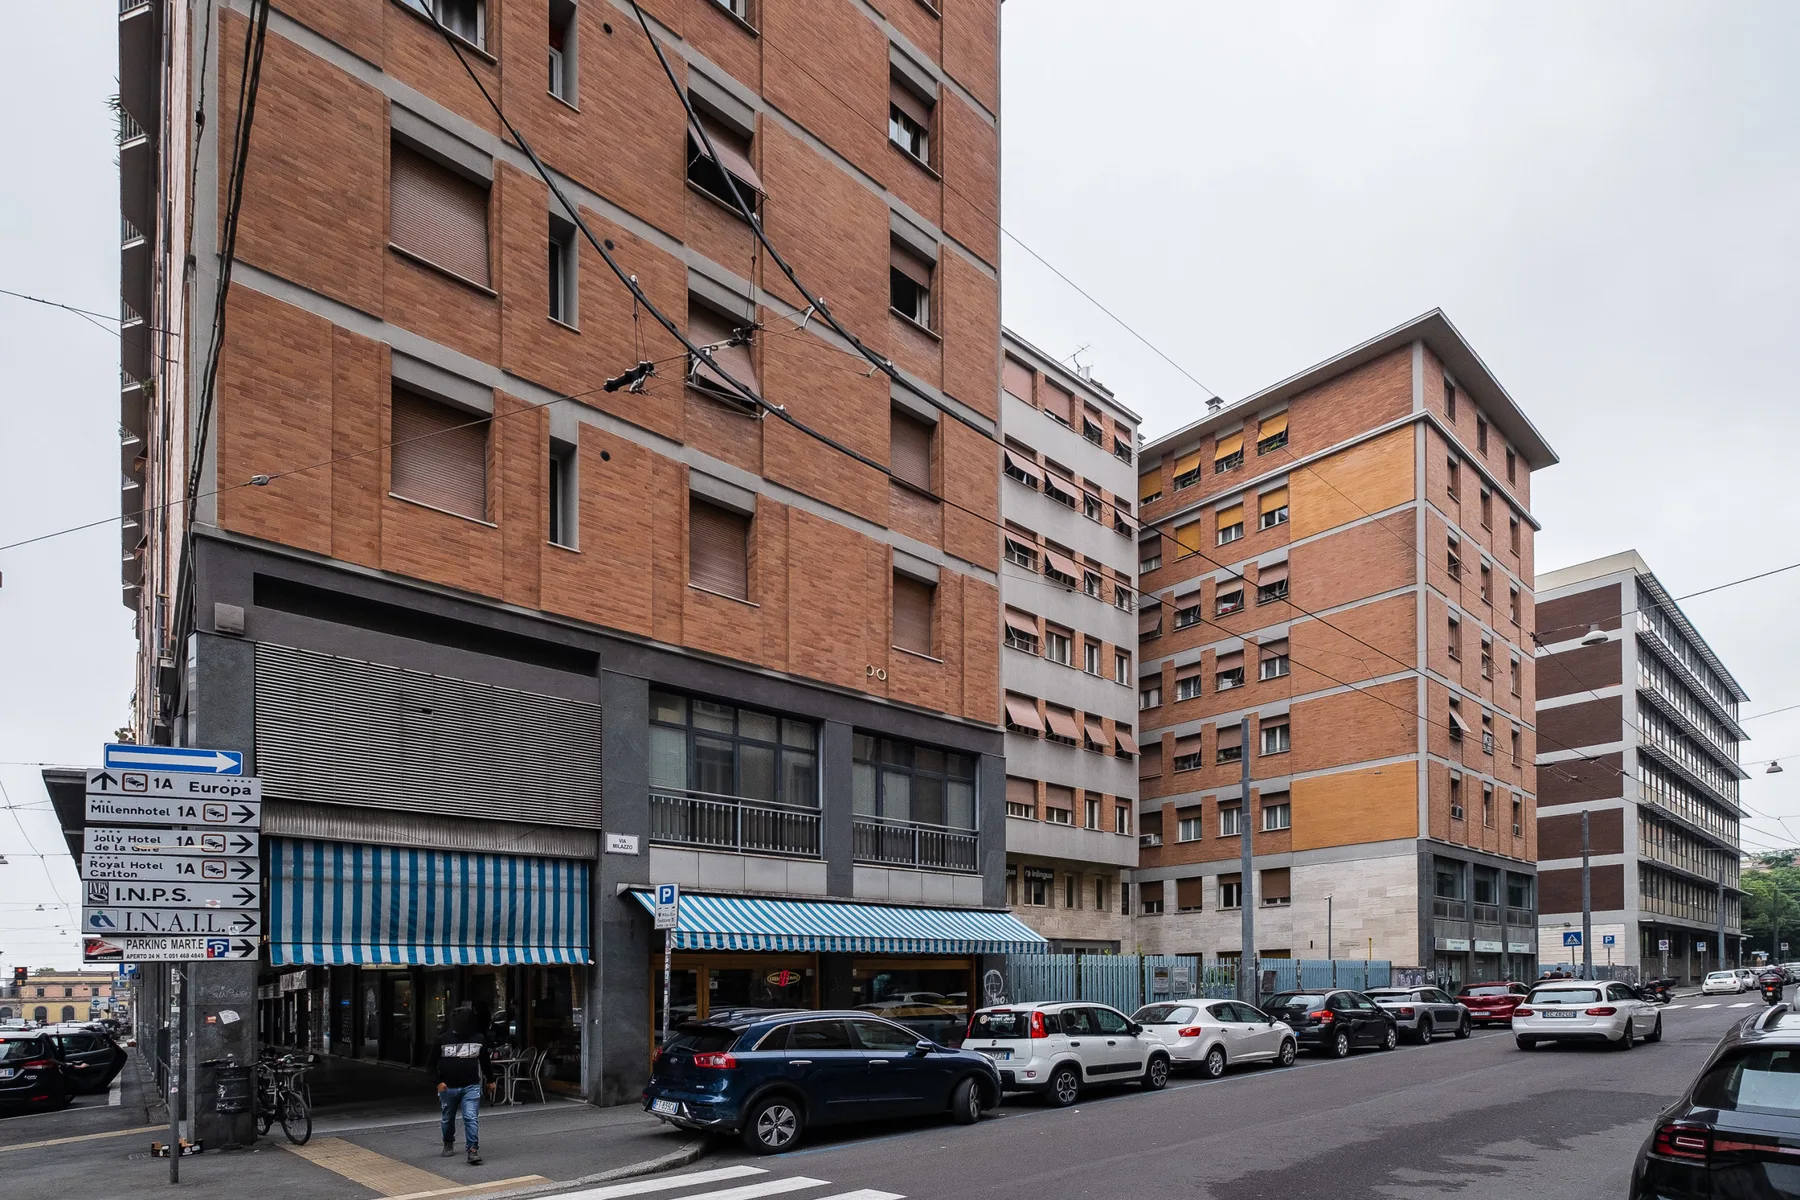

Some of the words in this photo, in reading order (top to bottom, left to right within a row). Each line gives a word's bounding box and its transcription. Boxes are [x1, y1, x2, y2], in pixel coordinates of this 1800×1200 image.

[154, 778, 173, 790] 1A
[189, 781, 252, 796] Europa
[91, 804, 171, 816] Millennhotel
[178, 806, 197, 818] 1A
[93, 834, 123, 844] Jolly
[128, 835, 161, 844] Hotel
[176, 836, 196, 848] 1A
[94, 844, 109, 852] de
[114, 844, 126, 852] la
[90, 860, 125, 870] Royal
[130, 861, 163, 871] Hotel
[176, 863, 196, 875] 1A
[90, 869, 138, 879] Carlton
[89, 882, 108, 894] INPS
[115, 887, 192, 902] I.N.P.S.
[662, 887, 672, 902] P
[125, 911, 226, 933] I.N.A.I.L.
[126, 939, 167, 950] PARKING
